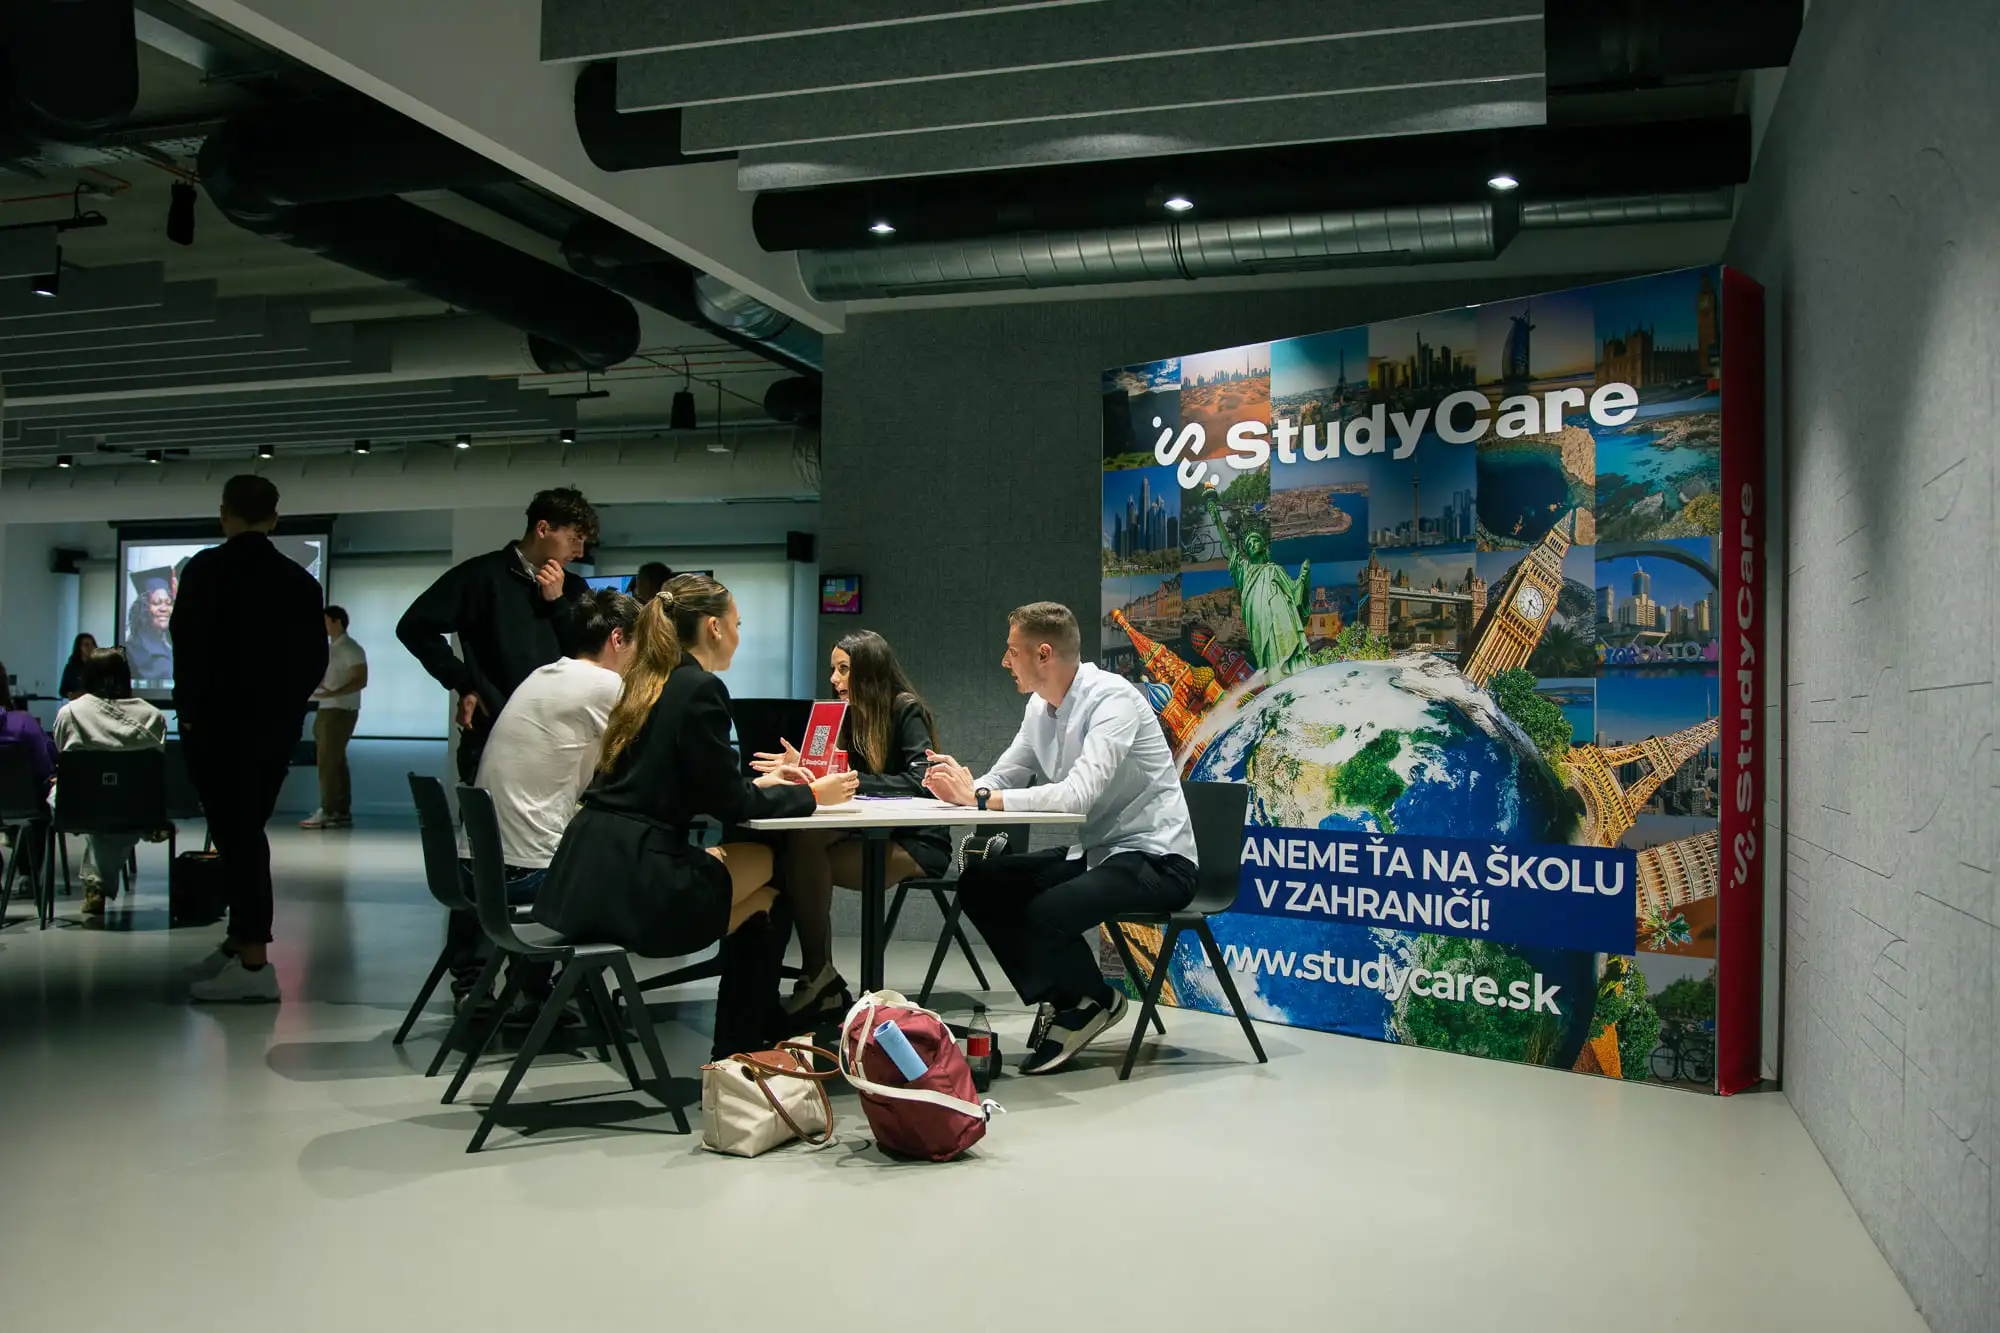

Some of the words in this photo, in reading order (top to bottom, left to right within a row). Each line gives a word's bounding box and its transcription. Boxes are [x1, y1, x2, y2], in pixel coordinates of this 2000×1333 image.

[1225, 382, 1639, 471] StudyCare
[1737, 482, 1756, 814] StudyCare
[1366, 837, 1415, 879] ŤA
[1422, 849, 1479, 885] NA
[1486, 844, 1625, 896] ŠKOLU
[1254, 878, 1279, 908] V
[1285, 881, 1490, 932] ZAHRANIČÍ!
